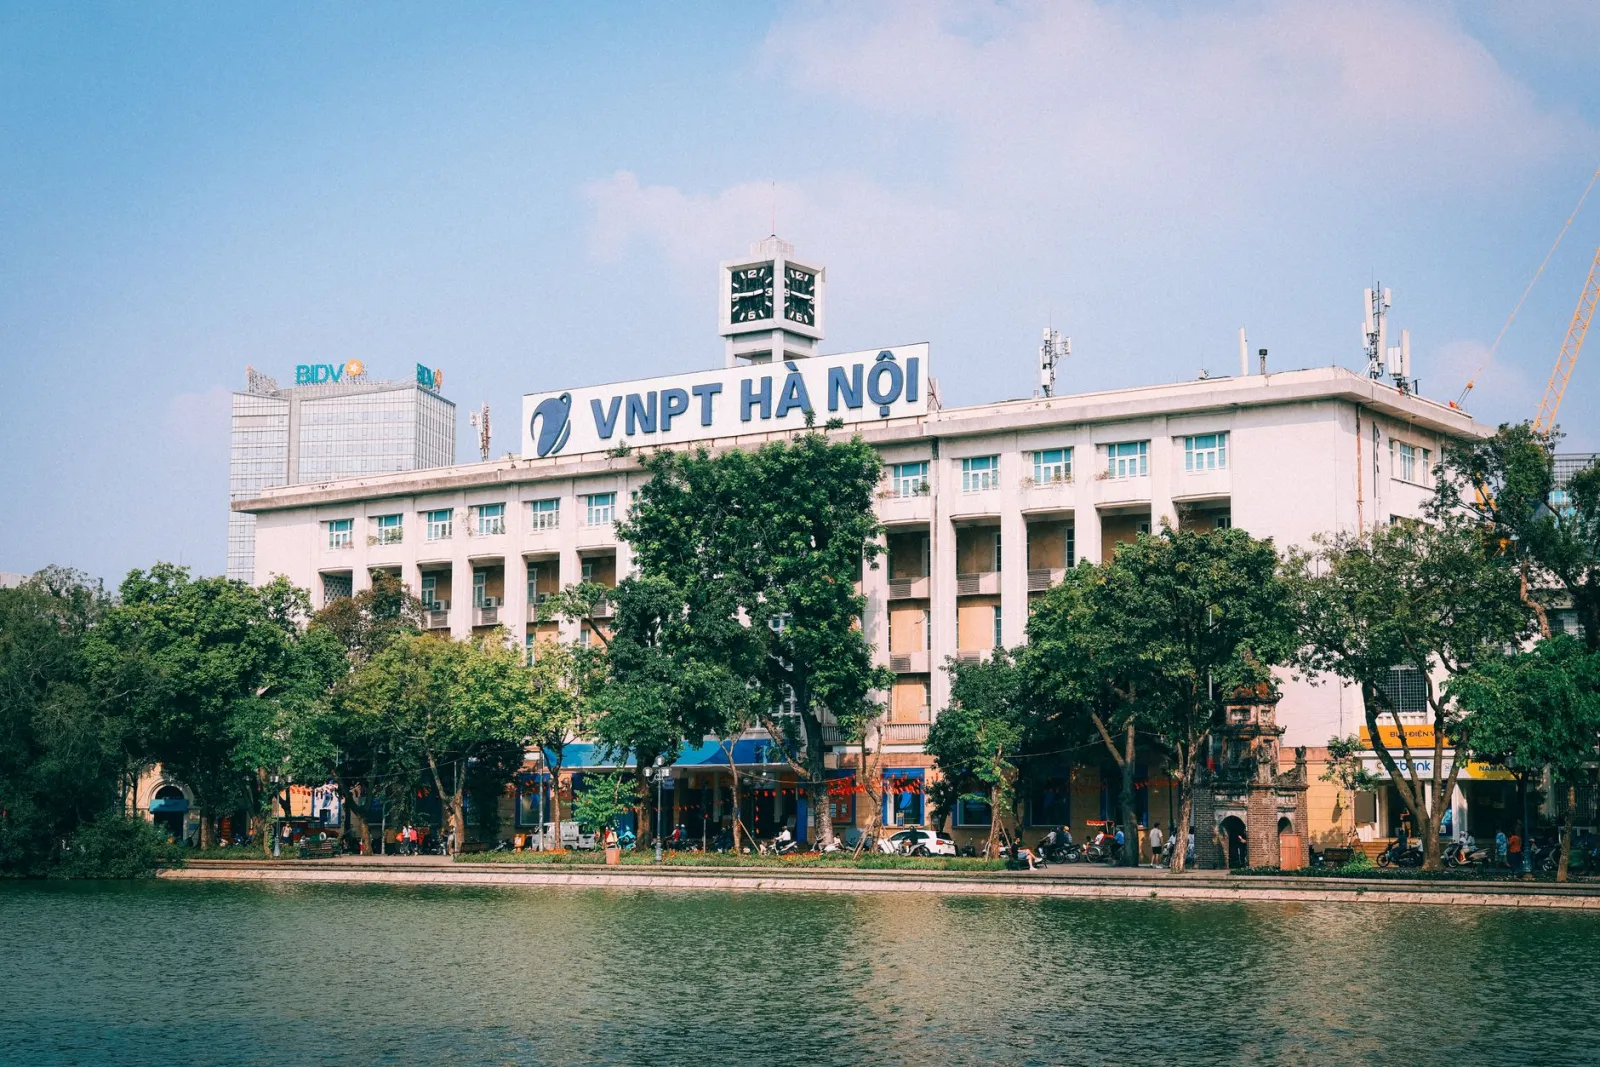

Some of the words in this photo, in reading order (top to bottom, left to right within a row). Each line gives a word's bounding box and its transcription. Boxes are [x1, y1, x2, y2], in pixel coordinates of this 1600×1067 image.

[748, 270, 757, 278] 12
[796, 272, 804, 280] 12
[748, 311, 755, 319] 6
[296, 364, 345, 383] BIDV
[417, 363, 435, 388] BIDV
[589, 382, 722, 439] VNPT
[740, 361, 811, 422] HÀ
[827, 350, 920, 417] NỘI
